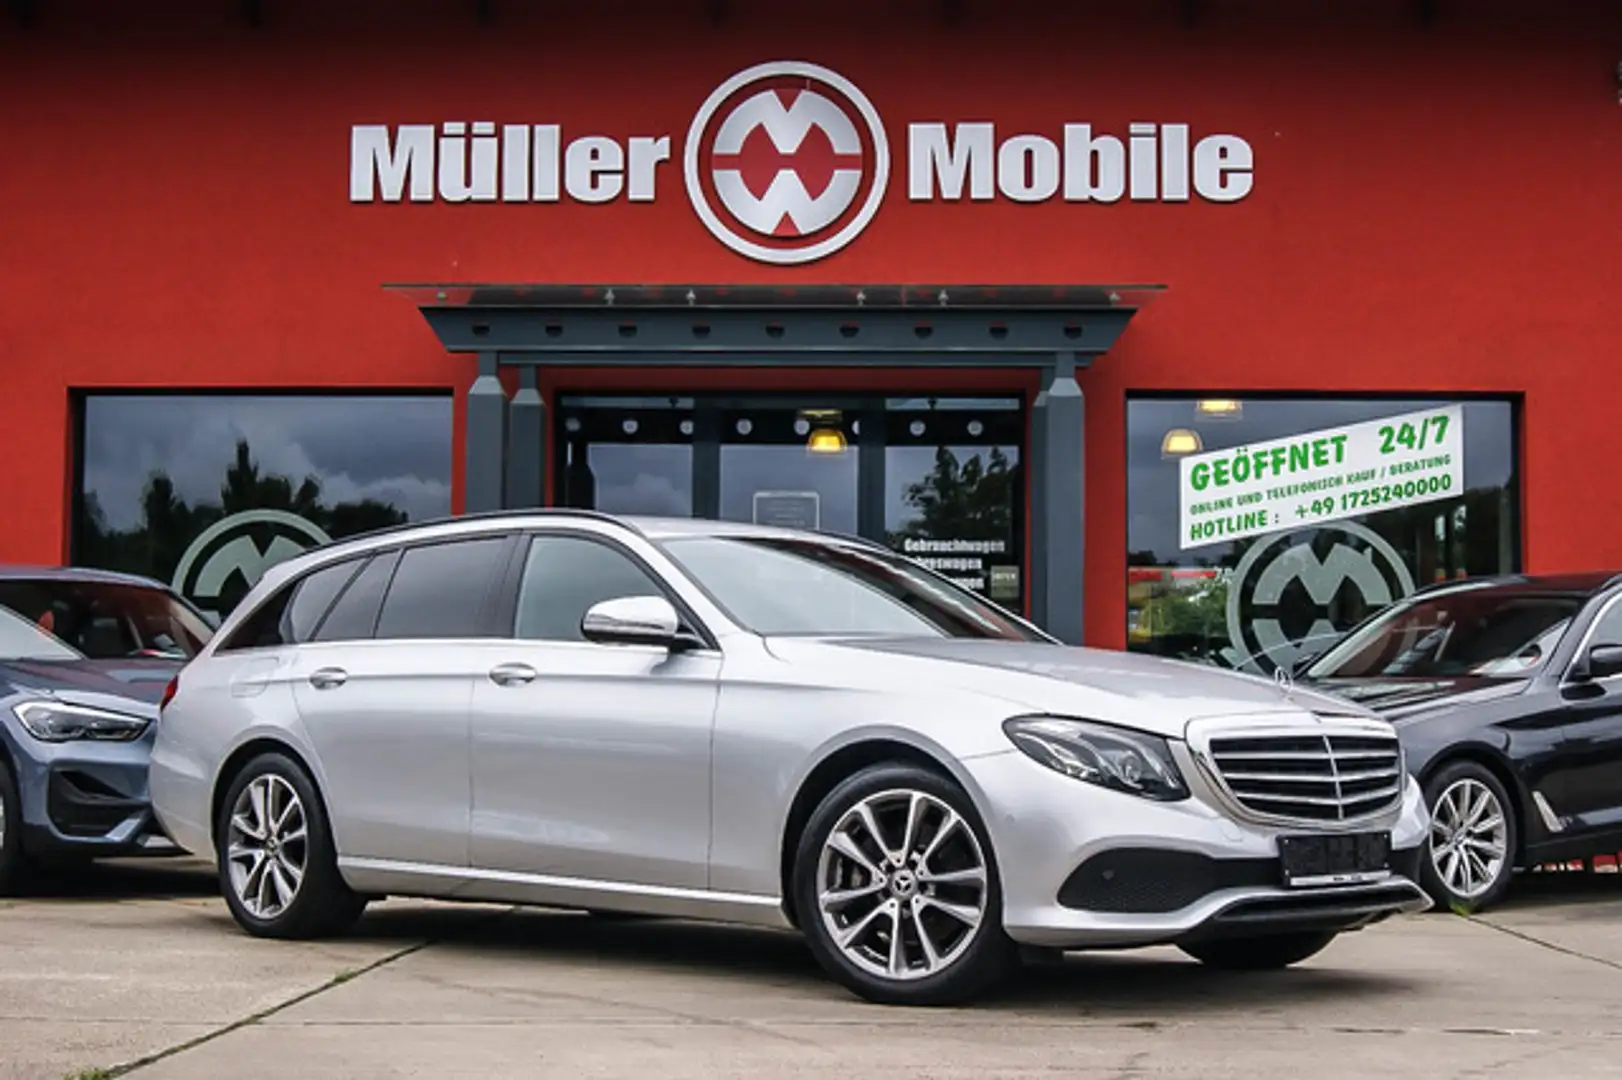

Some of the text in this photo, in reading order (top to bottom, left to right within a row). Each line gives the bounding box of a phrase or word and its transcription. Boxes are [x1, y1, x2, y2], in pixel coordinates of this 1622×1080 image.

[350, 122, 1254, 203] Müller Mobile
[1190, 415, 1449, 491] GEÖFFNET 24/7
[1190, 497, 1234, 515] ONLINE
[1237, 491, 1261, 506] UND
[1266, 475, 1343, 501] TELEFONISCH
[1346, 468, 1376, 485] KAUF
[1389, 454, 1451, 477] BERATUNG
[1190, 510, 1268, 540] HOTLINE
[1295, 497, 1335, 519] +49
[1340, 474, 1452, 511] 1725240000
